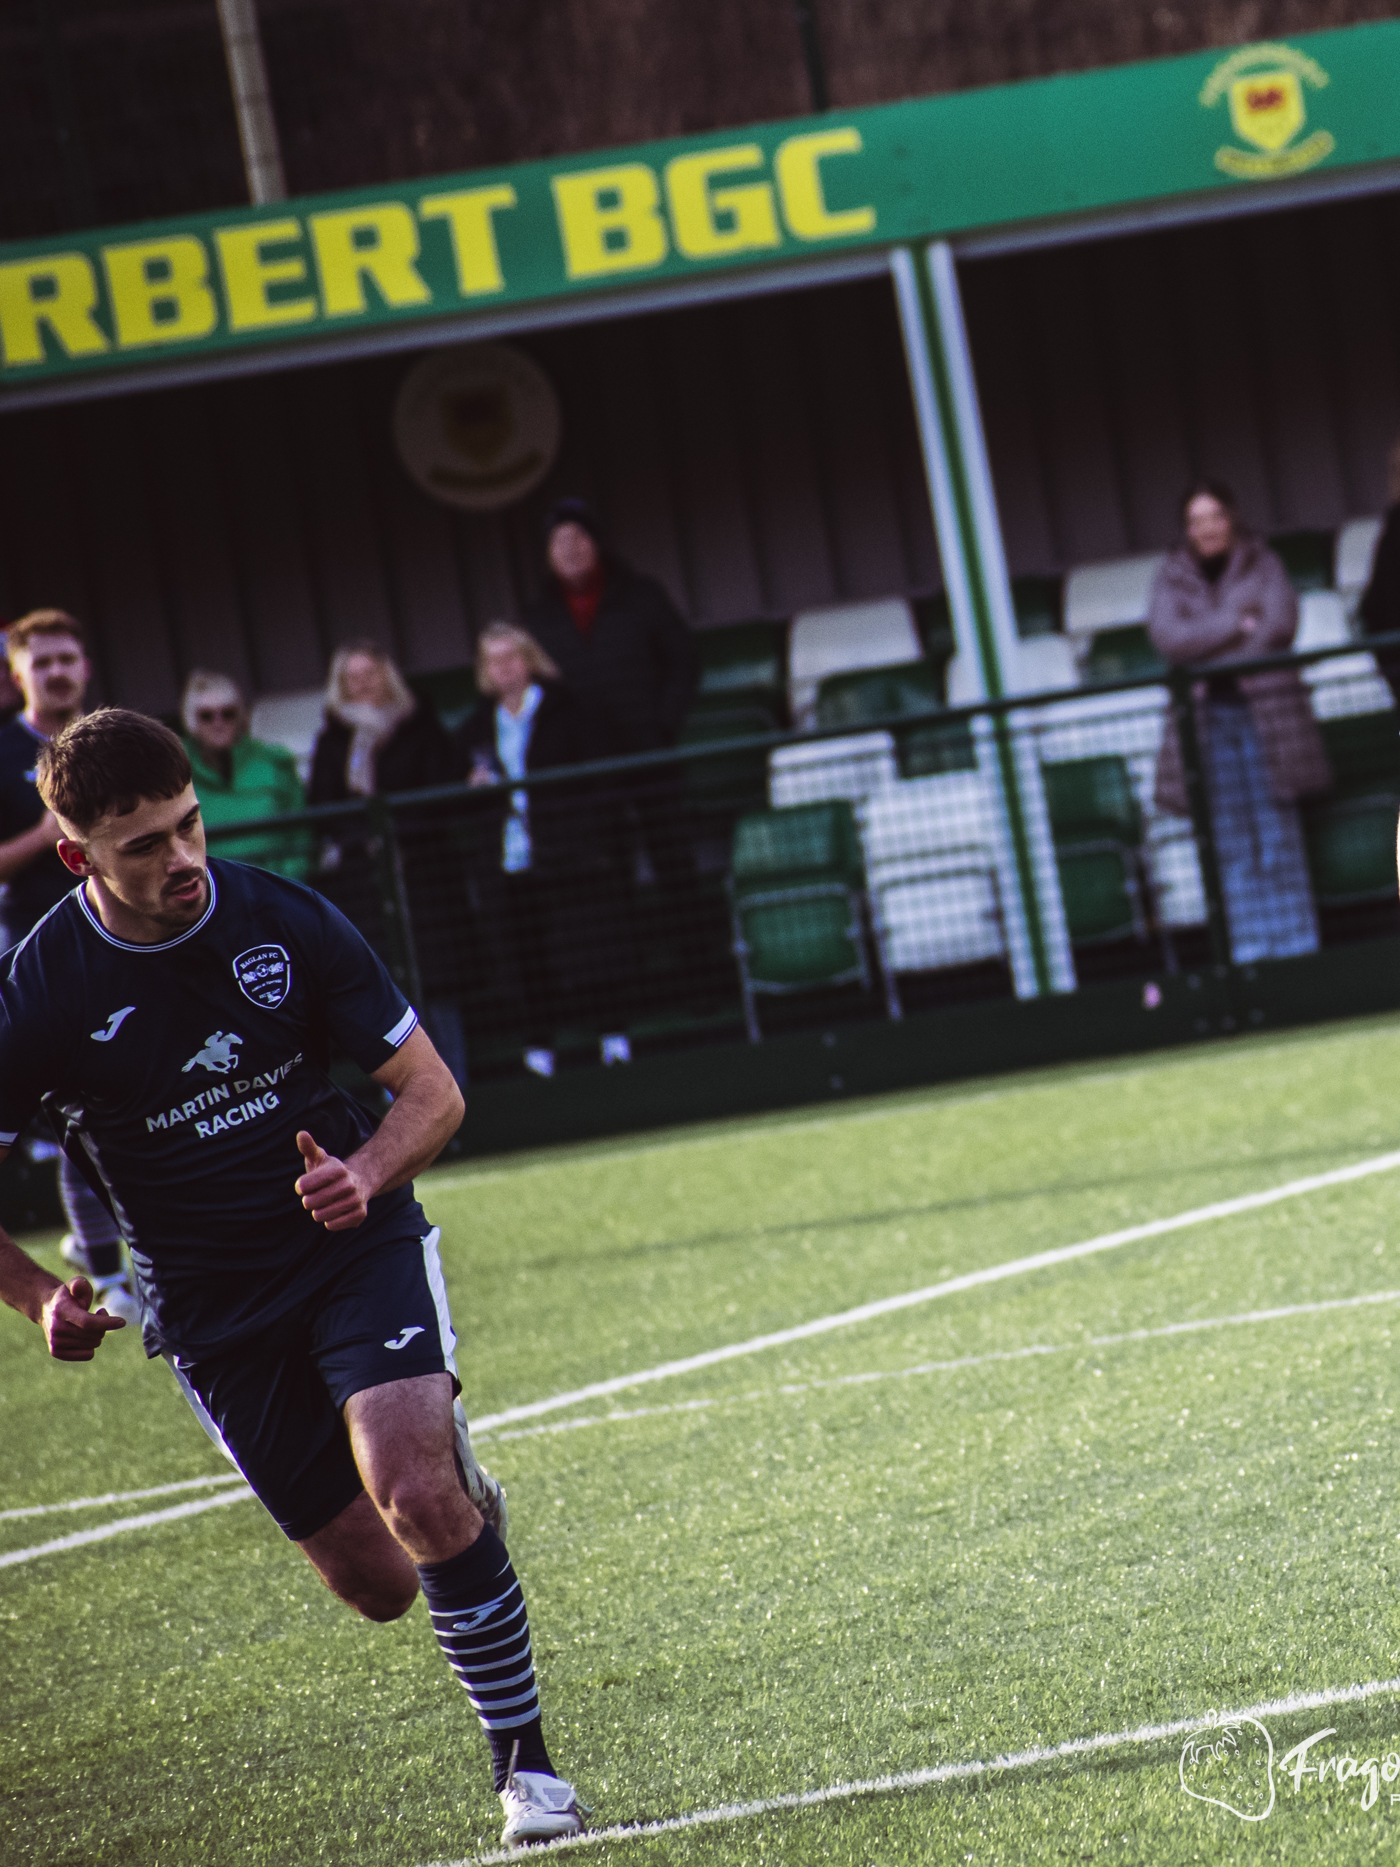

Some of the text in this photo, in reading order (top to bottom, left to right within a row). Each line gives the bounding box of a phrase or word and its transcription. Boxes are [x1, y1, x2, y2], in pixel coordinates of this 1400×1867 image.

[551, 128, 876, 280] BGC
[240, 953, 267, 969] BAGLAN
[145, 1053, 304, 1133] MARTIN DAVIES
[194, 1091, 281, 1139] RACING
